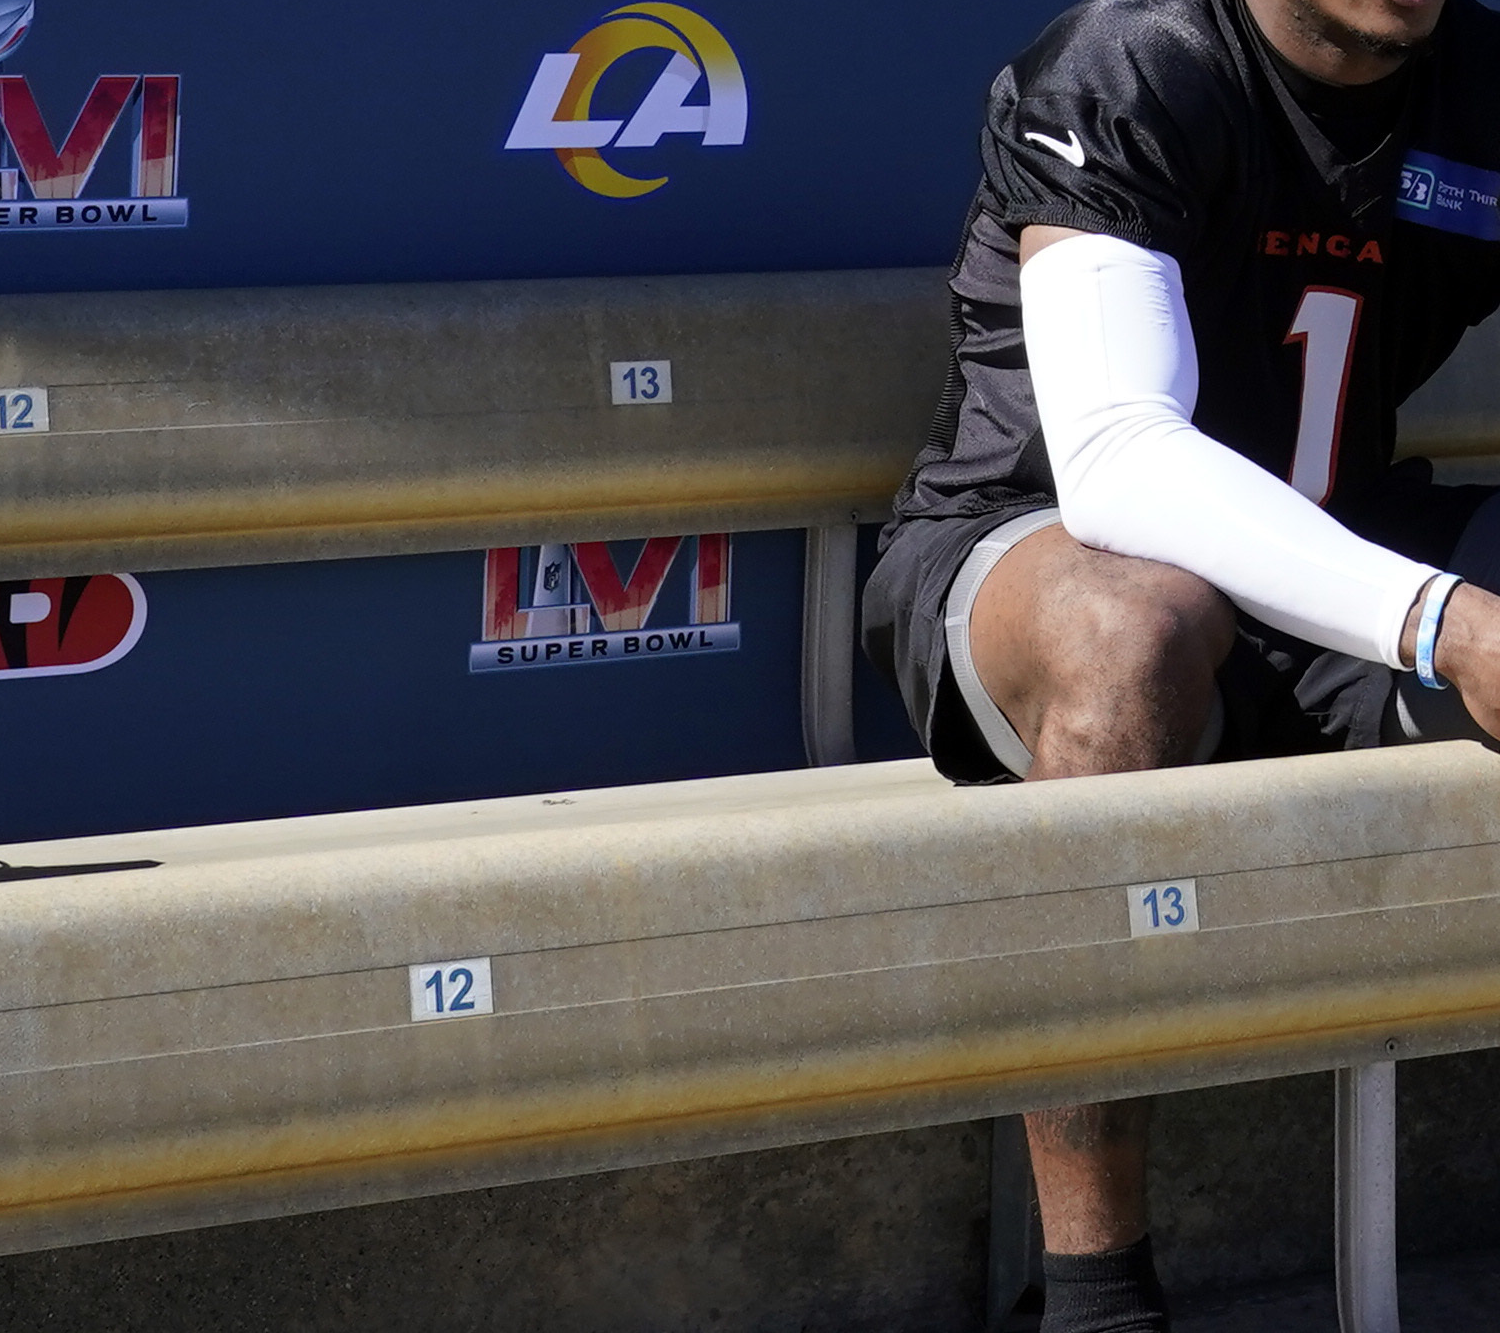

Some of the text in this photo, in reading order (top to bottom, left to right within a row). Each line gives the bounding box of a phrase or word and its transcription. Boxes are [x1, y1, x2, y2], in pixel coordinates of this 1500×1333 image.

[505, 4, 747, 148] LA
[55, 203, 159, 224] BOWL
[1467, 188, 1499, 207] THIR
[623, 367, 659, 399] 13
[1283, 285, 1363, 508] 1
[496, 628, 715, 664] SUPER BOWL
[1142, 887, 1184, 929] 13
[426, 968, 474, 1012] 12
